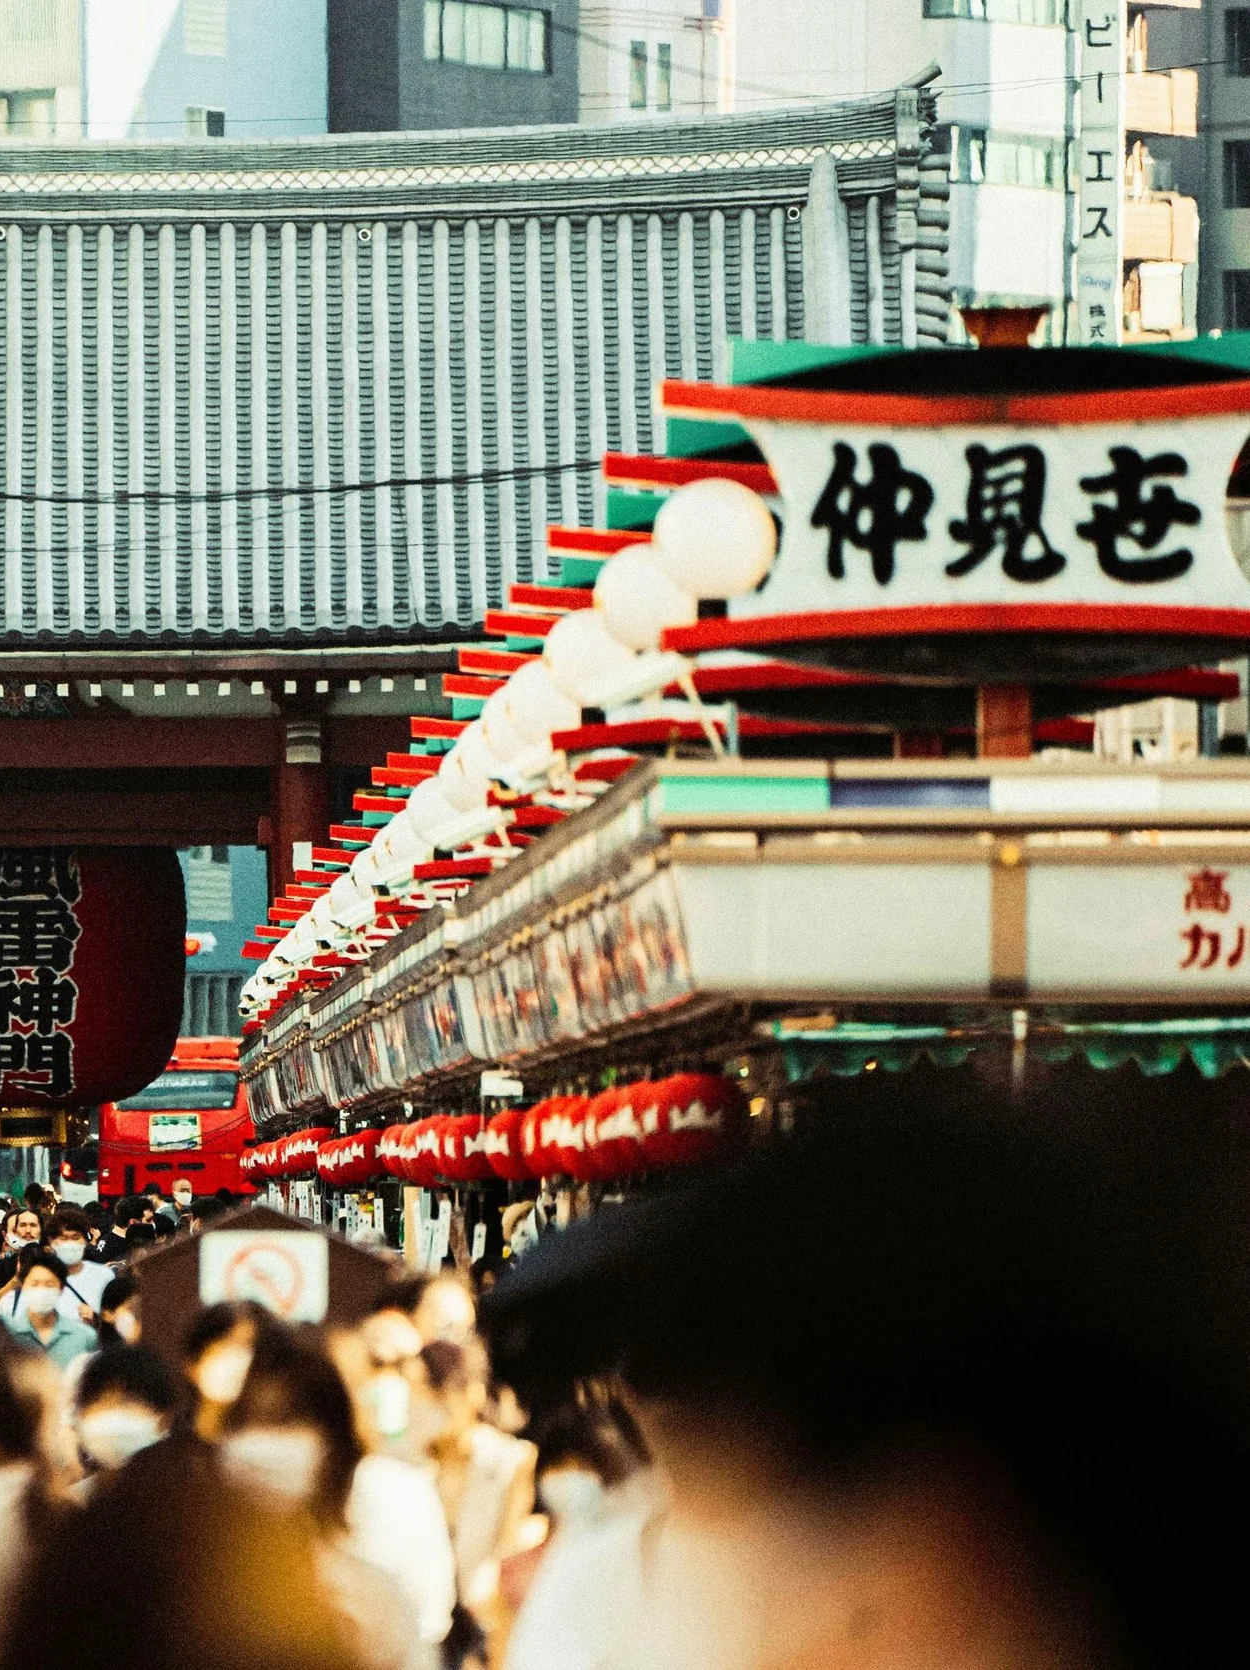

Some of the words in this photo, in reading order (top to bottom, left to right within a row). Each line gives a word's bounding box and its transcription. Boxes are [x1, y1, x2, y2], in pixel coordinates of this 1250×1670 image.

[1083, 15, 1117, 240] ビーエス
[809, 440, 1203, 586] 仲見世
